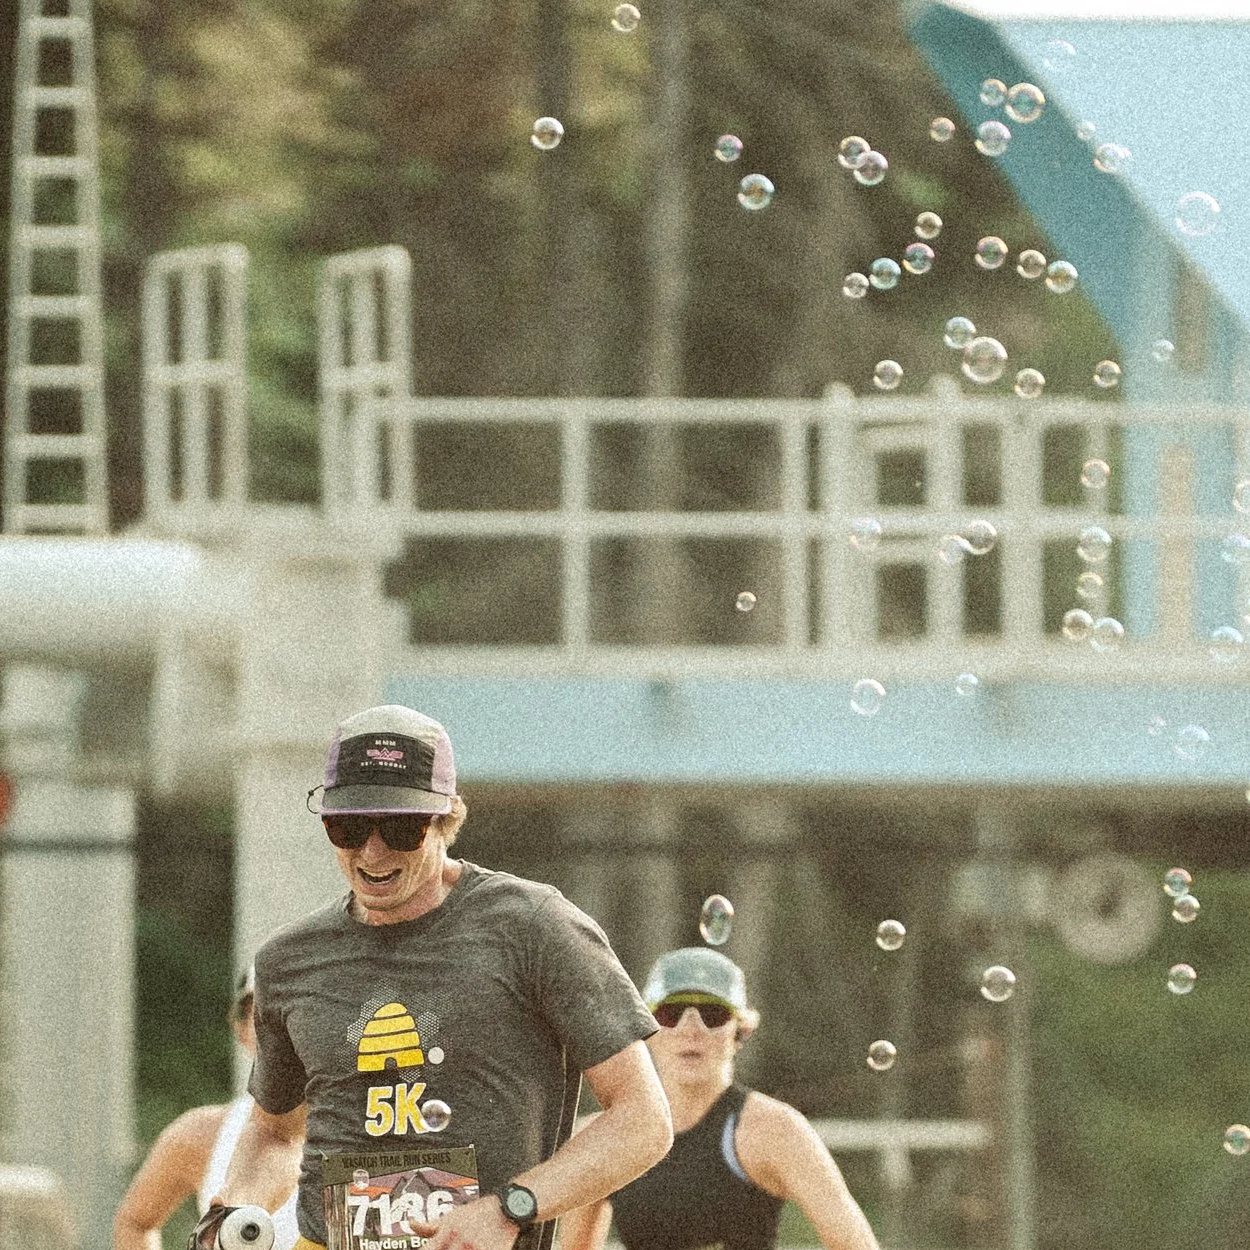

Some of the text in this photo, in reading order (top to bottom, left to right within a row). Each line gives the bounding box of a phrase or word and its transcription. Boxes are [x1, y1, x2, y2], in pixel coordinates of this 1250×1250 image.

[365, 1082, 430, 1136] 5K
[380, 1154, 402, 1167] TRAIL
[403, 1153, 421, 1165] RUN
[422, 1152, 451, 1165] SERIES
